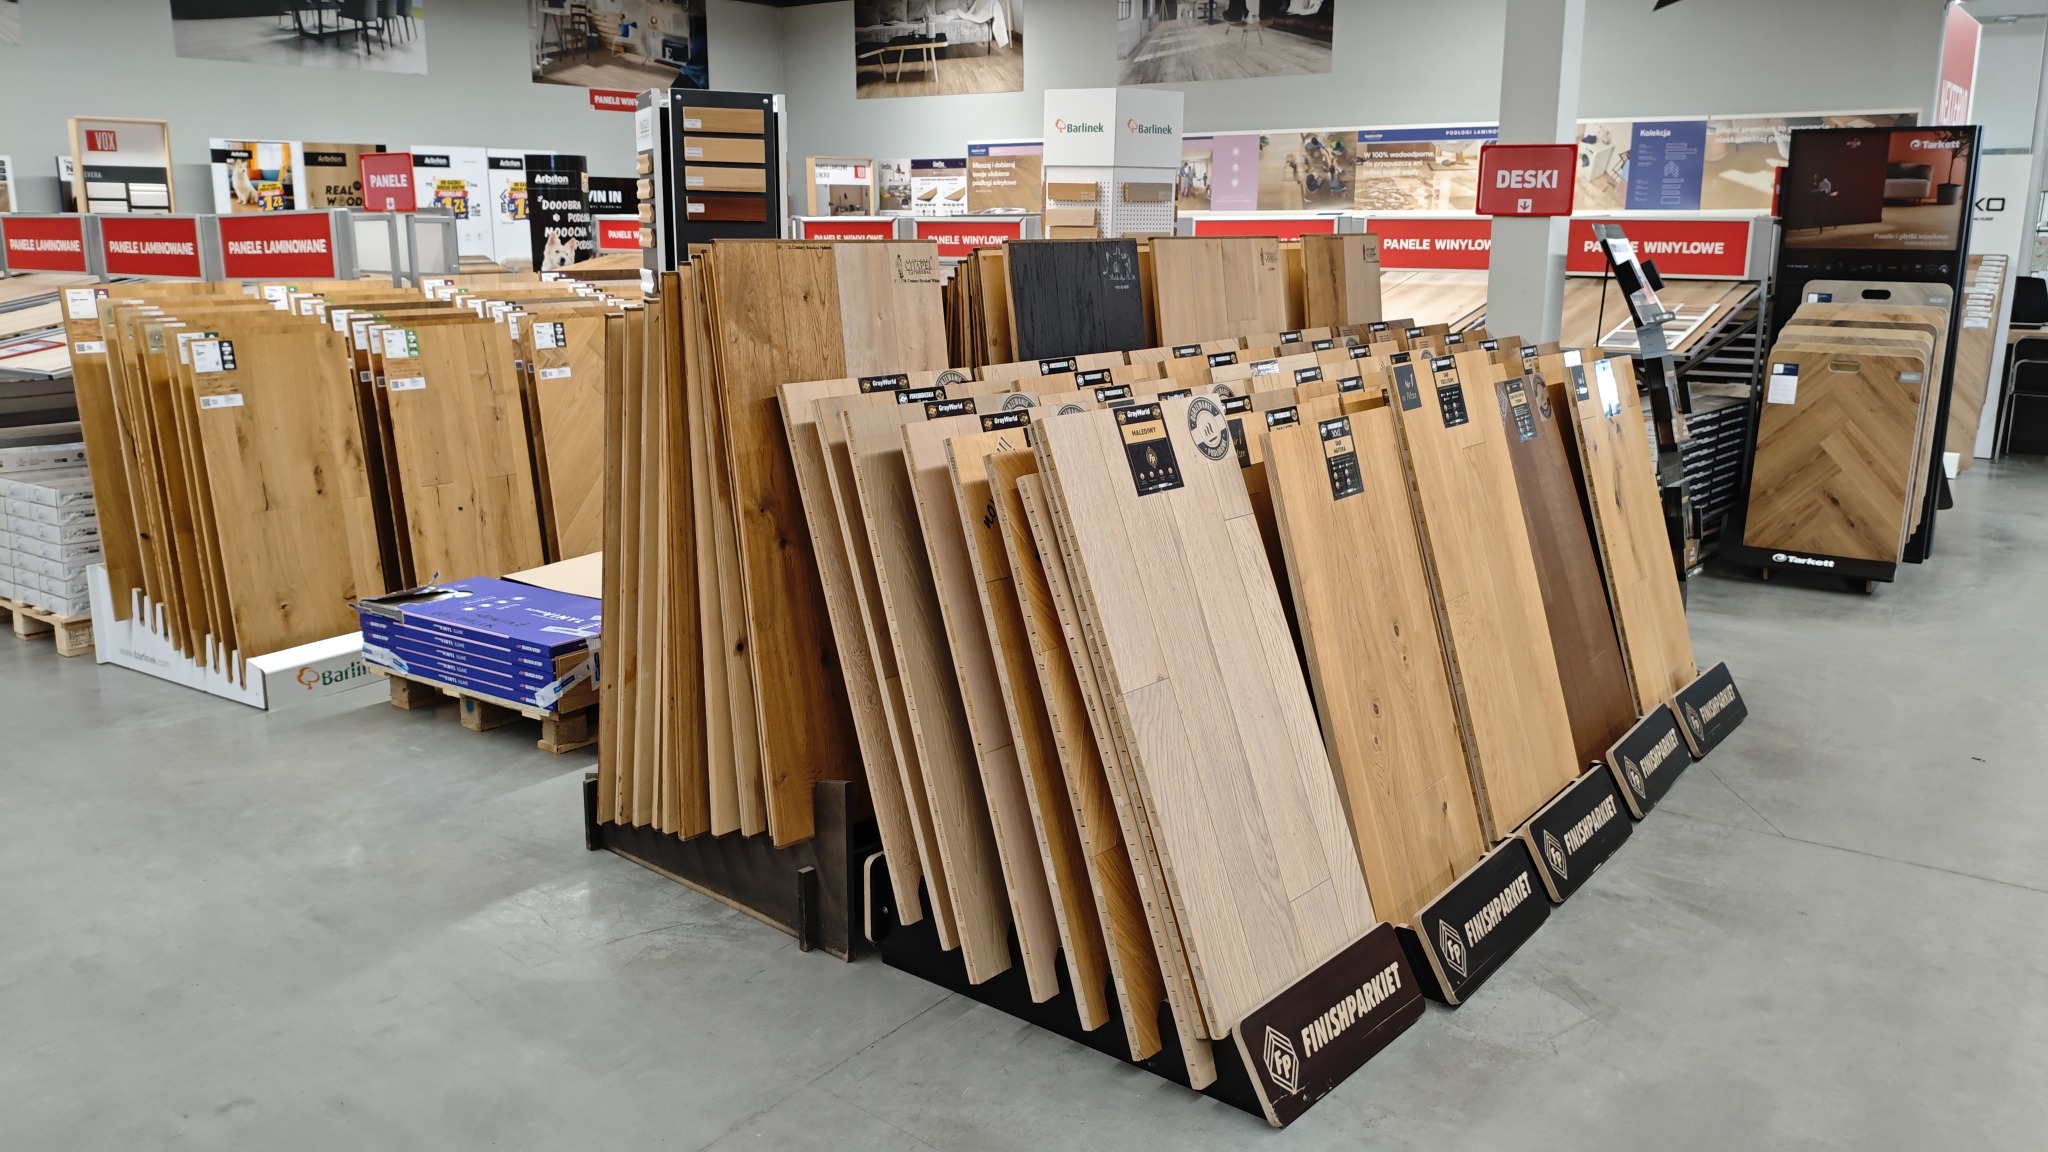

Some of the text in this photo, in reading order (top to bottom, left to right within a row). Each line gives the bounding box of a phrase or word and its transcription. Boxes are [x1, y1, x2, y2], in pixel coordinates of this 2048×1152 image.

[594, 95, 639, 106] PANELE WINY
[1066, 121, 1104, 134] Barlinek
[1137, 123, 1173, 136] Barlinek
[1639, 129, 1672, 138] Kolekcja
[94, 130, 117, 151] VOX
[1921, 140, 1960, 149] Tarkett
[424, 156, 448, 166] Arbiton
[499, 159, 522, 168] Arbiton
[369, 173, 408, 188] PANELE
[534, 173, 569, 185] Arbiton
[1496, 169, 1559, 189] DESKI
[325, 185, 354, 195] REAL
[607, 230, 633, 240] PANELE
[928, 234, 1009, 246] PANELE WINYLOWE
[9, 239, 81, 253] PANELE LAMINOWANE
[109, 240, 195, 256] PANELE LAMINOWANE
[228, 238, 327, 255] PANELE LAMINOWANE
[1383, 238, 1492, 251] PANELE WINYLOW
[1643, 240, 1725, 255] WINYLOWE
[904, 261, 933, 271] CHAPEL
[872, 378, 897, 387] GrayWorld
[938, 402, 963, 412] GrayWorld
[1126, 408, 1151, 419] GrayWorld
[1189, 399, 1213, 421] OGRZEWANIE
[993, 414, 1018, 425] GrayWorld
[1131, 427, 1156, 437] MALEDIWY
[1786, 554, 1836, 569] Tarkett
[321, 660, 369, 686] Barli
[1699, 683, 1736, 725] FINISHPARKIET
[1639, 727, 1679, 779] FINISHPARKIET
[1563, 794, 1618, 856] FINISHPARKIET
[1463, 870, 1532, 948] FINISHPARKIET
[1300, 960, 1402, 1059] FINISHPARKIET
[1273, 1049, 1291, 1079] FP
